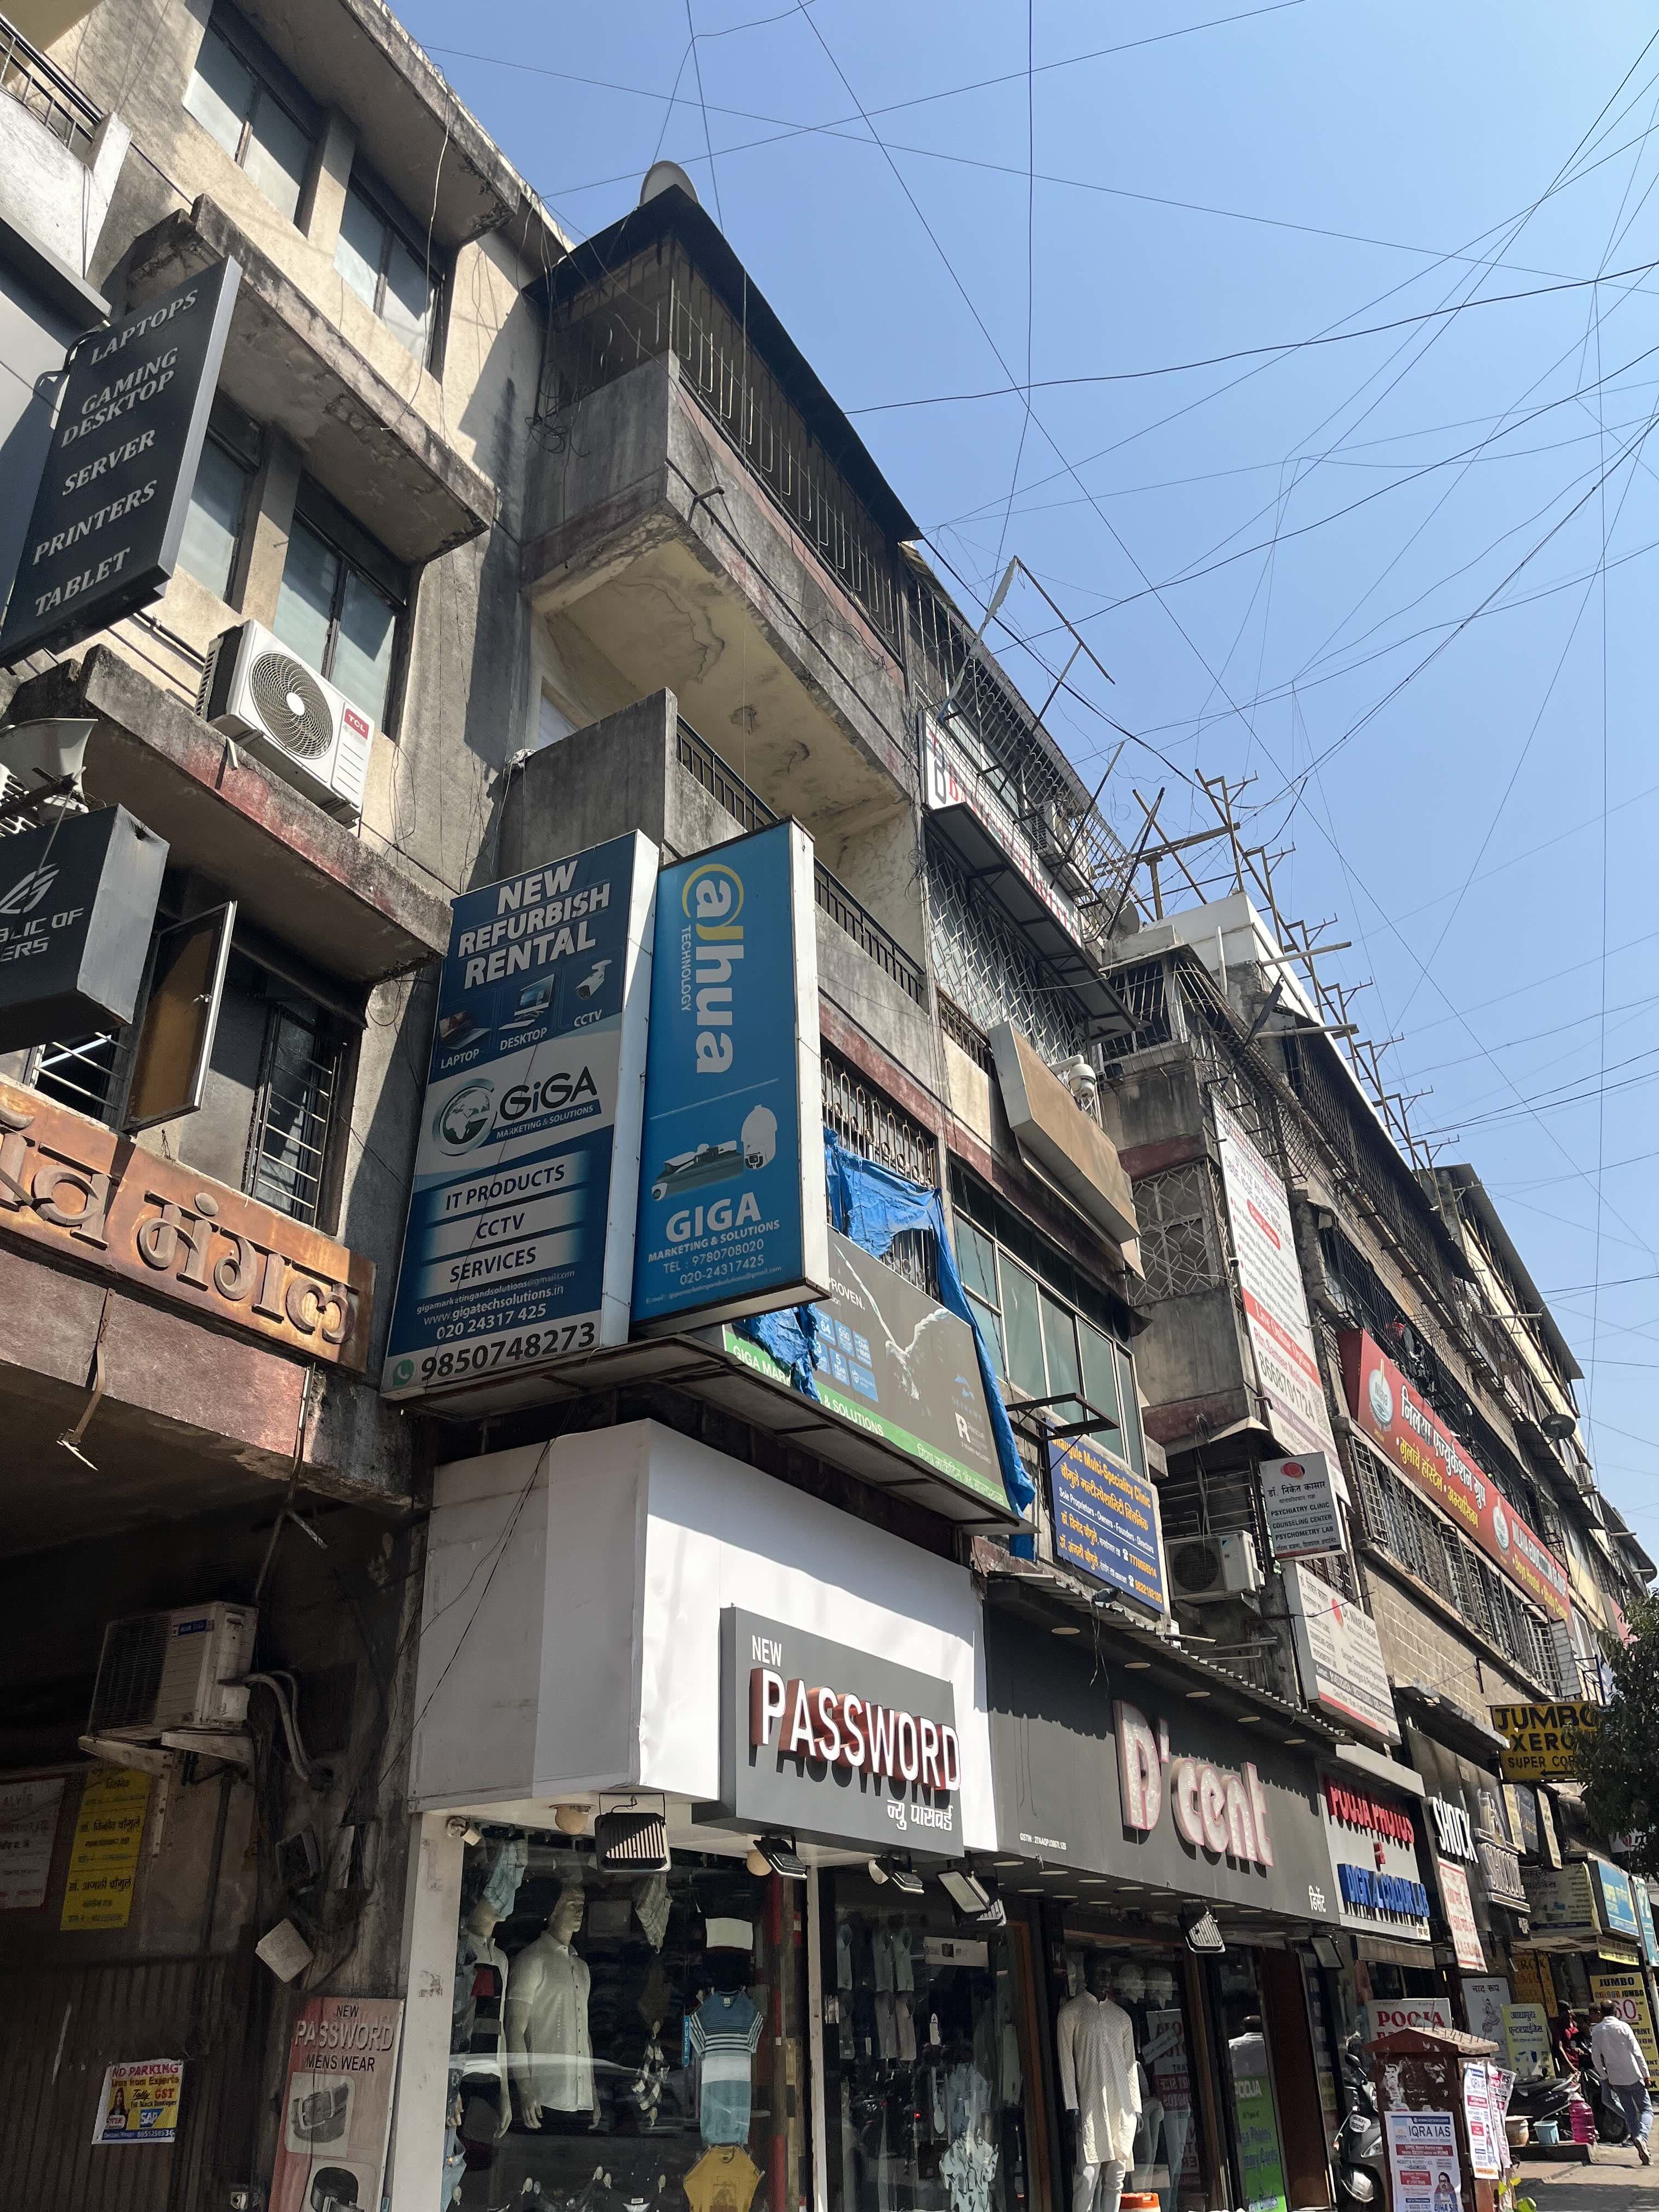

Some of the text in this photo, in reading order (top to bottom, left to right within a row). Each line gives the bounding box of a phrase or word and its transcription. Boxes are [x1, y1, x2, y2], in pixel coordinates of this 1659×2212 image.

[90, 290, 198, 365] LAPTOPS
[81, 348, 178, 415] GAMING
[61, 370, 174, 448] DESKTOP
[63, 430, 156, 496] SERVER
[32, 480, 157, 565] PRINTERS
[35, 547, 131, 617] TABLET
[348, 714, 366, 733] TCL
[498, 860, 578, 915] NEW
[52, 907, 84, 928] OF
[458, 883, 610, 957] REFURBISH
[464, 921, 597, 990] RENTAL
[681, 924, 691, 1012] TECHNOLOGY
[574, 1009, 602, 1027] CCTV
[500, 1028, 548, 1051] DESKTOP
[441, 1049, 479, 1069] LAPTOP
[496, 1105, 594, 1139] MARKETING & SOLUTIONS
[445, 1164, 565, 1210] IT PRODUCTS
[477, 1213, 525, 1239] CCTV
[666, 1192, 761, 1243] GIGA
[648, 1220, 780, 1263] MARKETING & SOLUTIONS
[663, 1261, 680, 1274] TEL
[692, 1239, 764, 1266] 9780708020
[450, 1246, 537, 1283] SERVICES
[679, 1255, 764, 1285] 020-24317425
[424, 1285, 564, 1325] www.gigatechsolutions.in
[829, 1277, 866, 1310] ROVEN.
[436, 1323, 464, 1340] 020
[517, 1303, 547, 1321] 425
[821, 1323, 831, 1334] 64
[1255, 1302, 1271, 1329] Live
[1271, 1320, 1291, 1348] Online
[420, 1322, 595, 1381] 9850748273
[836, 1353, 841, 1365] 5
[733, 1345, 884, 1437] GIGA & SOLUTIONS
[1259, 1351, 1316, 1424] 8668701724
[1135, 1485, 1150, 1509] Clinic
[1267, 1487, 1278, 1497] डॉ.
[1282, 1483, 1301, 1495] निकेत
[1059, 1487, 1070, 1502] Sole
[1070, 1494, 1094, 1517] Proprietors
[1097, 1511, 1113, 1528] Owners
[1116, 1522, 1135, 1542] Founders
[1271, 1505, 1308, 1517] PSYCHIATRY
[1272, 1514, 1333, 1529] COUNSELING CENTER
[1276, 1528, 1321, 1541] PSYCHOMETRY
[752, 1635, 782, 1667] NEW
[749, 1668, 961, 1791] PASSWORD
[1495, 1703, 1598, 1729] JUMBO
[1510, 1733, 1574, 1752] XERO
[1508, 1756, 1546, 1768] SUPER
[887, 1799, 953, 1831] न्यु पासवर्ड
[1427, 1796, 1479, 1863] SHOCK
[1020, 1832, 1032, 1843] GSTIN
[1338, 1863, 1384, 1909] DIGITAL
[1413, 1882, 1430, 1917] LAB
[1599, 1977, 1635, 1987] JUMBO
[336, 2005, 359, 2018] NEW
[295, 2021, 395, 2052] PASSWORD
[112, 2063, 179, 2078] NO PARKING
[307, 2055, 375, 2072] MENS WEAR
[129, 2078, 146, 2086] from
[149, 2075, 179, 2086] Experts
[155, 2088, 174, 2099] GST
[140, 2113, 159, 2124] SAP
[1409, 2126, 1451, 2137] IQRA IAS
[1435, 2204, 1448, 2212] OJHA
